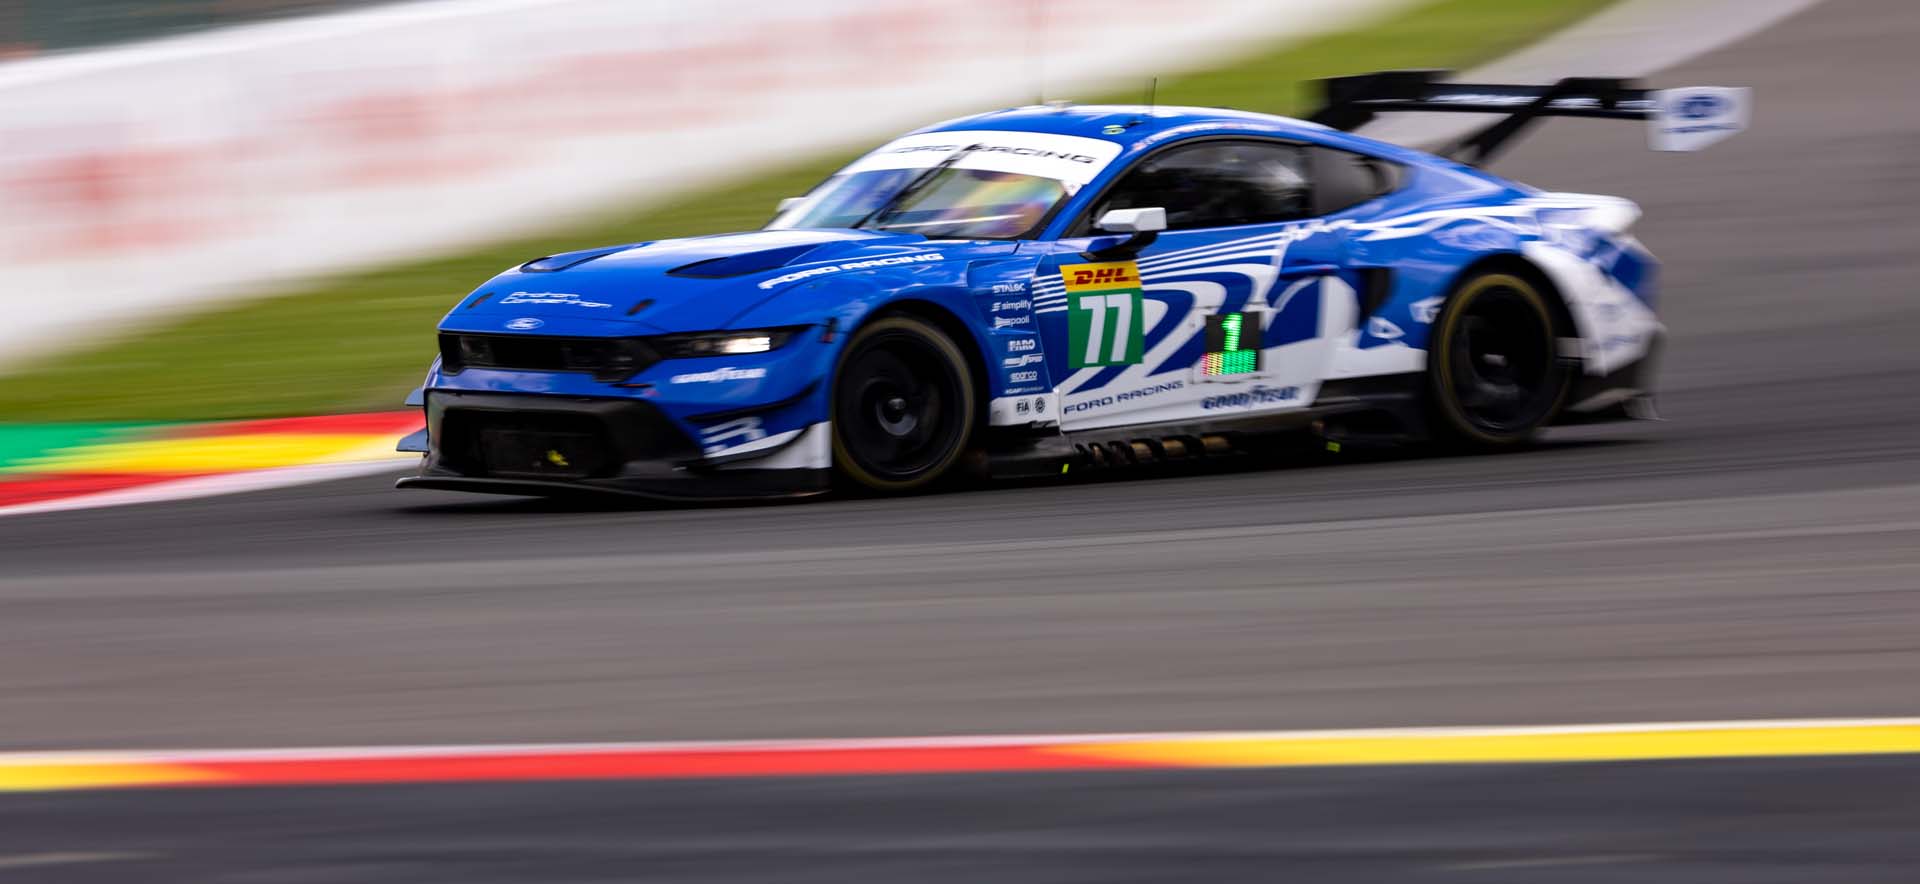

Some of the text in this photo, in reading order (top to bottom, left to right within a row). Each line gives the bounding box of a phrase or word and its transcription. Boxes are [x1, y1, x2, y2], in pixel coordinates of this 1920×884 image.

[757, 252, 945, 290] FORD RACING
[1074, 268, 1129, 285] DHL
[1002, 299, 1032, 311] simplify
[1079, 293, 1133, 364] 77
[1221, 312, 1243, 352] 1
[1008, 339, 1036, 352] FARO
[1010, 370, 1038, 381] sparco
[1063, 380, 1184, 415] FORD RACING
